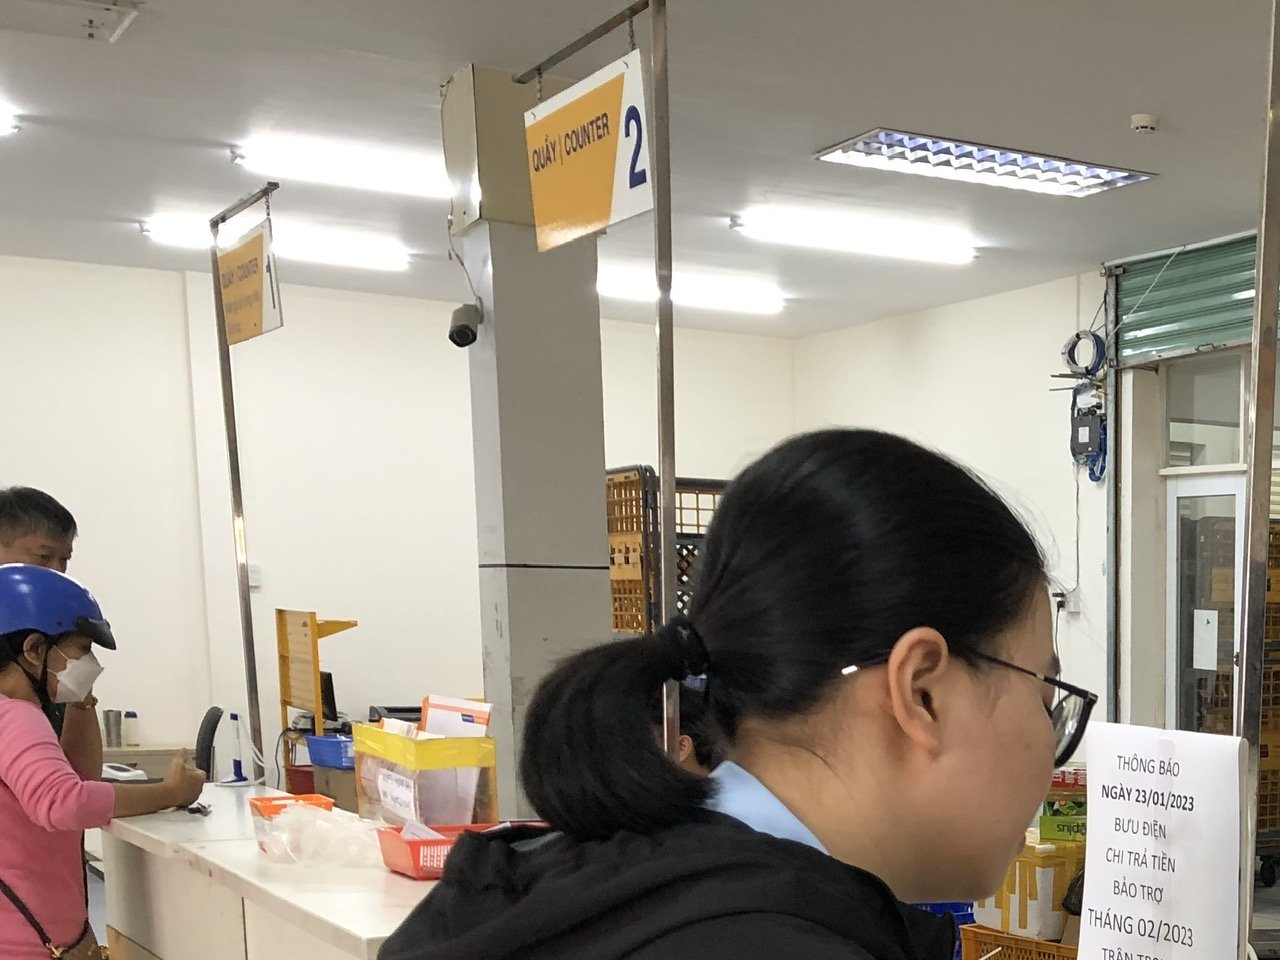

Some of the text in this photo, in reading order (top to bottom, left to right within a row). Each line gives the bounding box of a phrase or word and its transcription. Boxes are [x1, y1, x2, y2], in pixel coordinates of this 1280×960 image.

[564, 113, 610, 156] COUNTER
[625, 106, 647, 189] 2
[266, 254, 276, 309] 1
[1117, 753, 1180, 777] THÔNG BÁO
[1101, 783, 1195, 812] NGÀY 23/01/2023
[1114, 817, 1167, 840] BƯU ĐIỆN
[1105, 847, 1176, 873] CHI TRẢ TIỀN
[1113, 876, 1164, 905] BẢO TRỢ
[1088, 907, 1194, 948] THÁNG 02/2023
